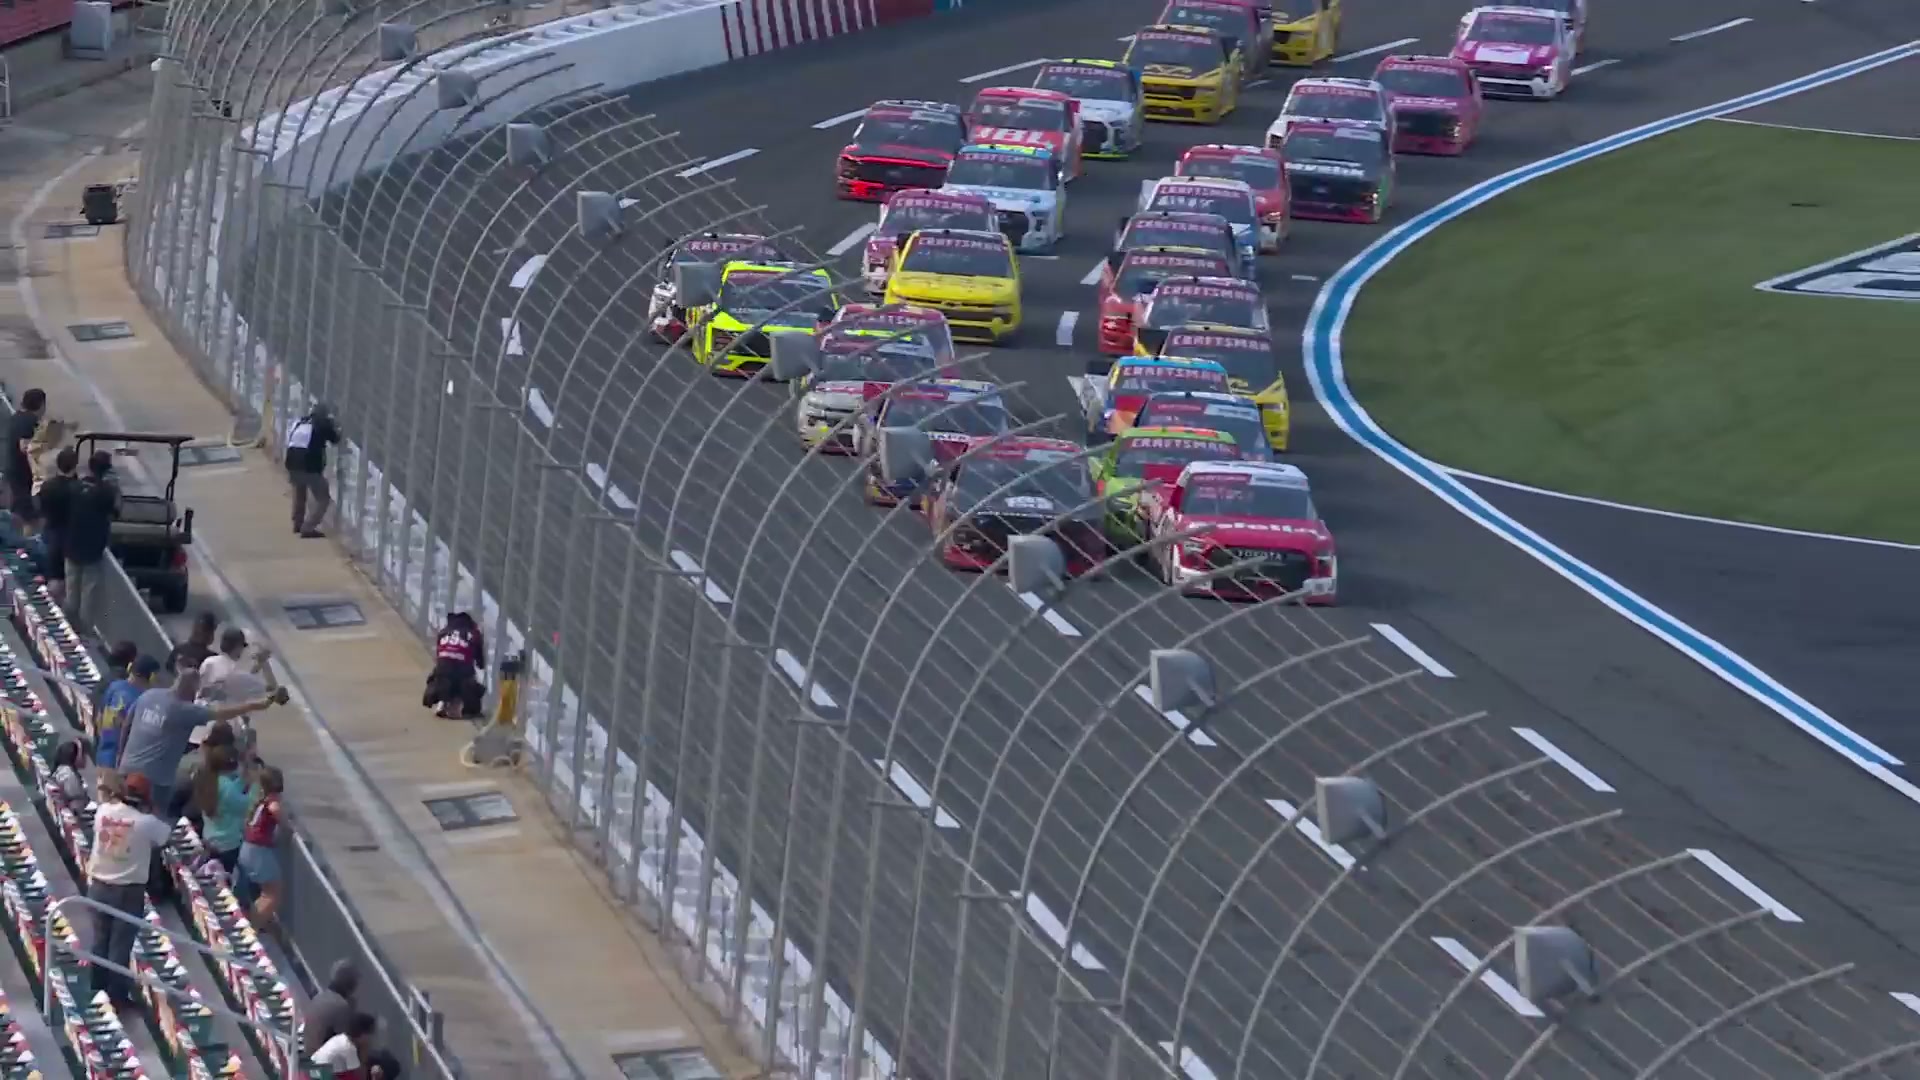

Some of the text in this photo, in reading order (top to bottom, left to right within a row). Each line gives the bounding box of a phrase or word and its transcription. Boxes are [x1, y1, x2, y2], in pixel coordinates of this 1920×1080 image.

[1163, 285, 1258, 302] CRAFTSMAN
[1173, 335, 1271, 351] CRAFTSMAN
[1123, 367, 1223, 382] CRAFTSMAN
[1131, 438, 1237, 455] CRAFTSMAN
